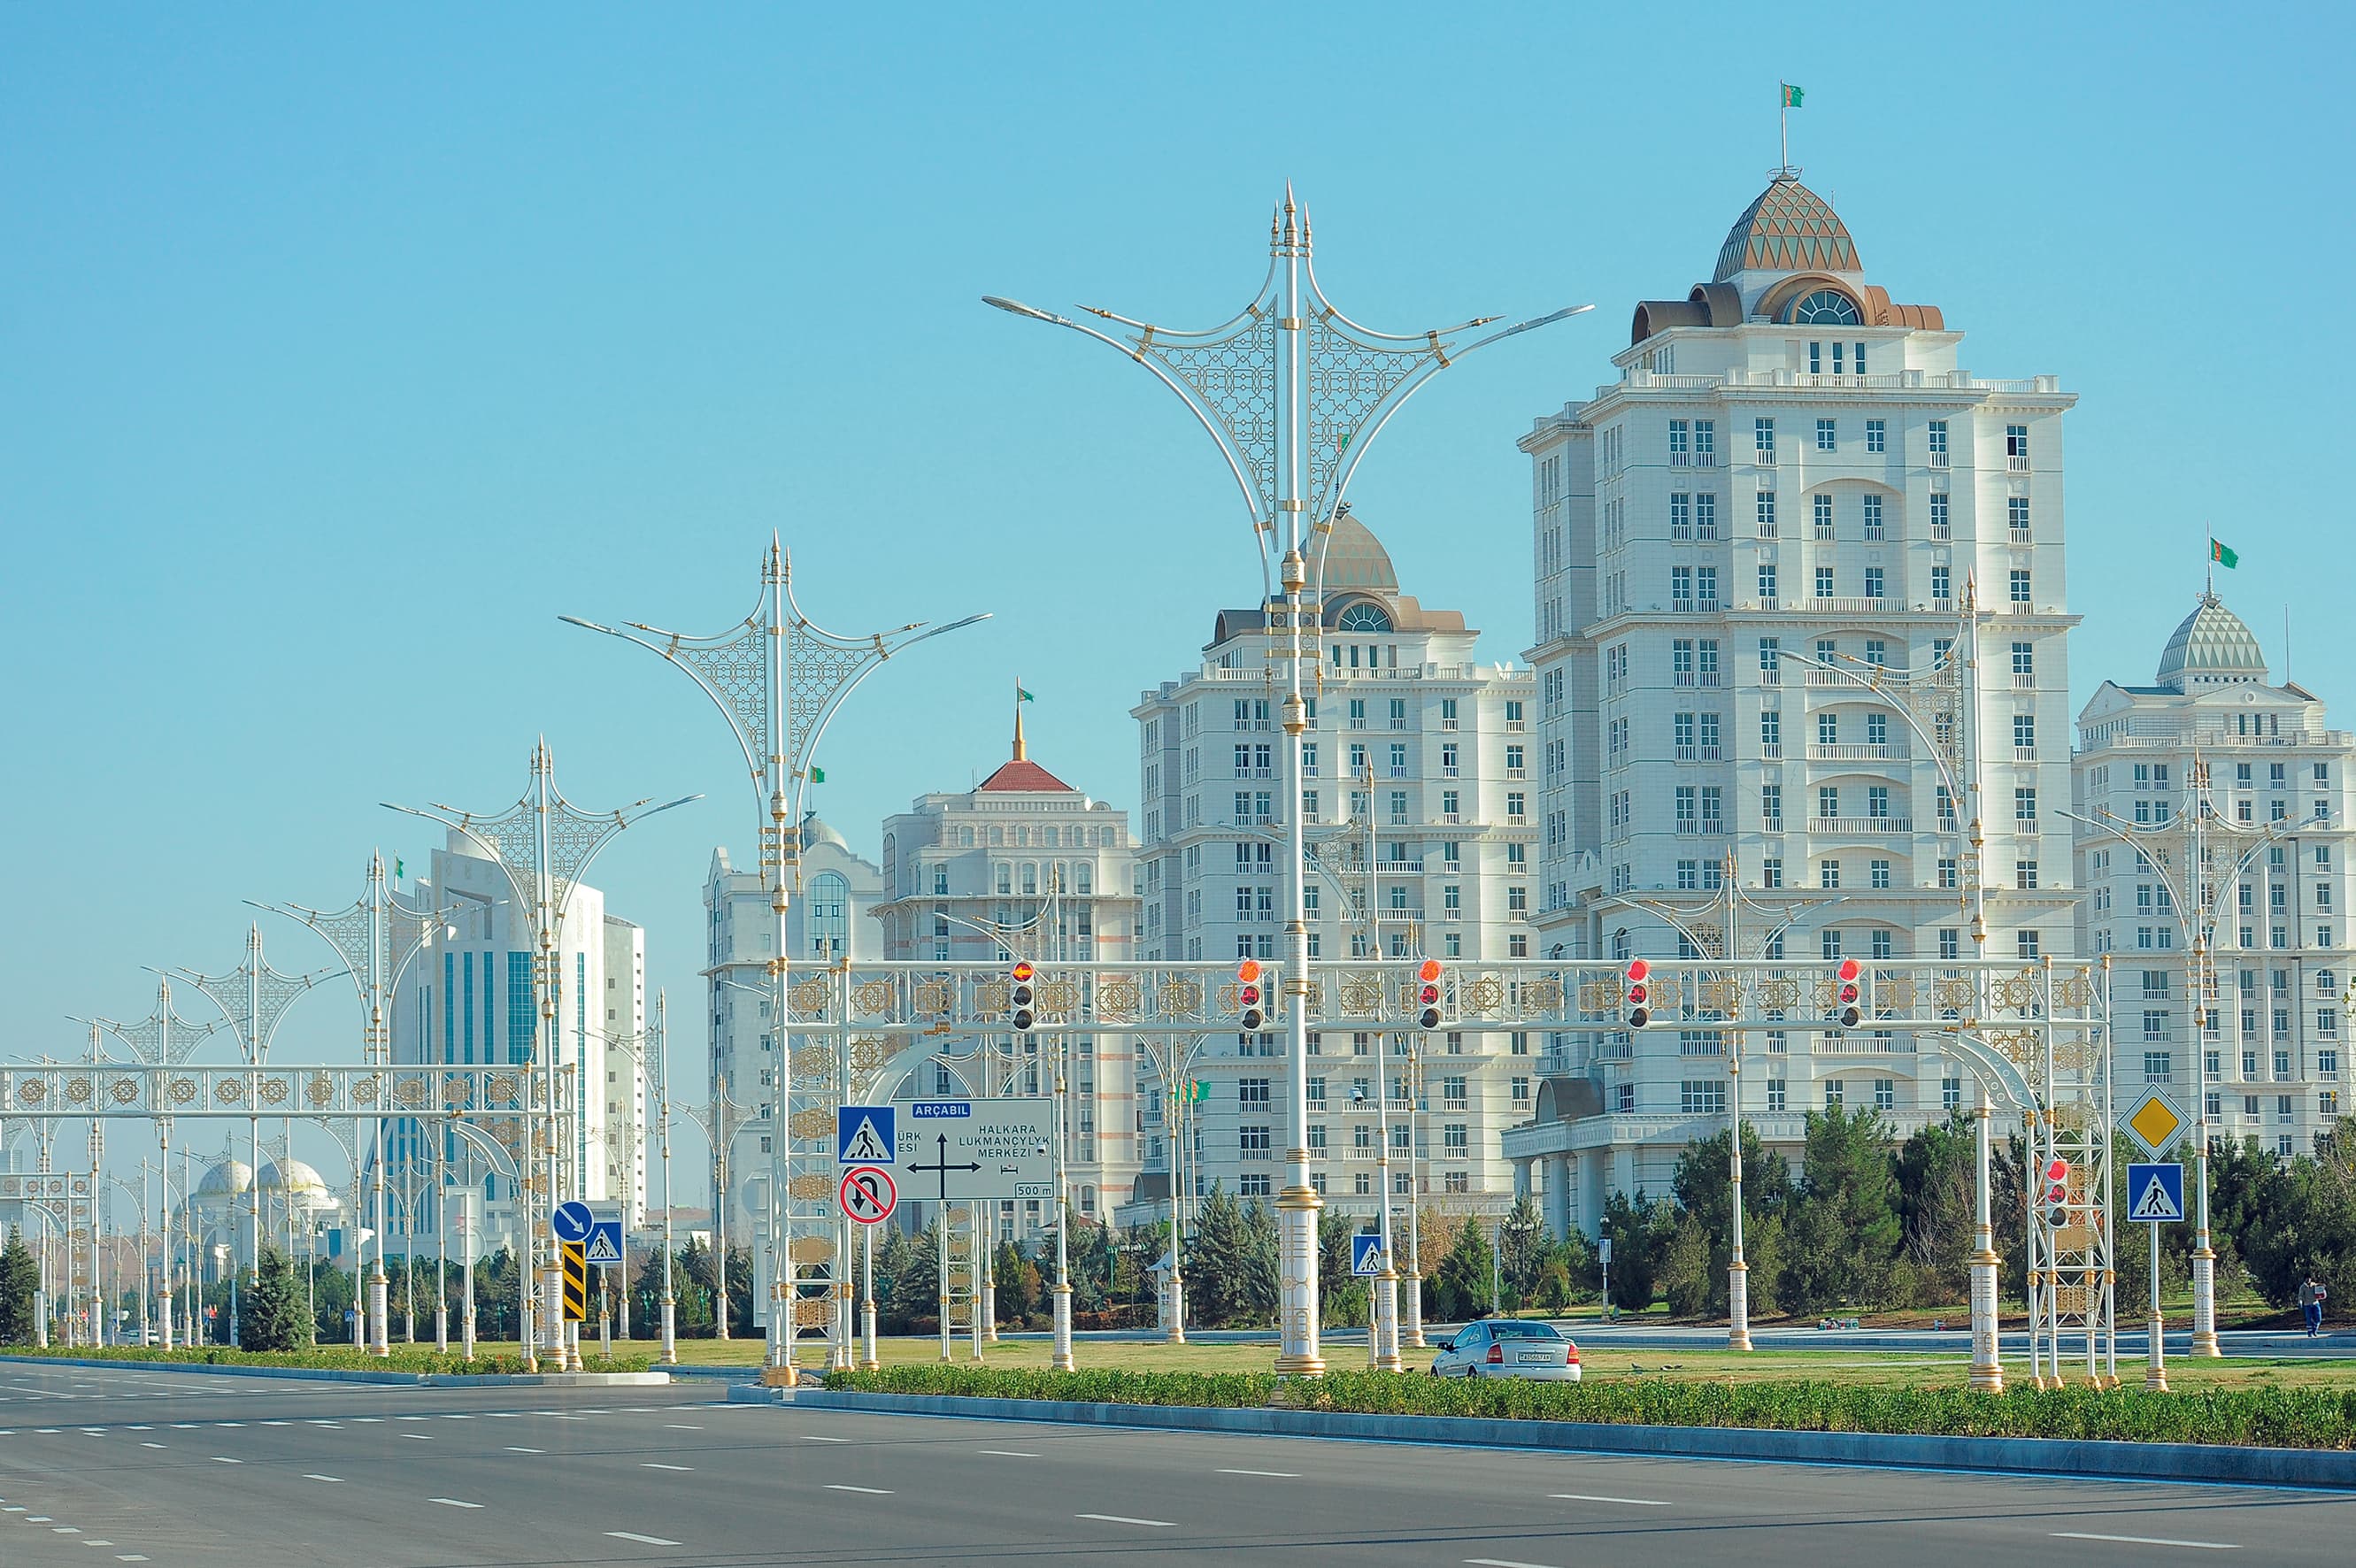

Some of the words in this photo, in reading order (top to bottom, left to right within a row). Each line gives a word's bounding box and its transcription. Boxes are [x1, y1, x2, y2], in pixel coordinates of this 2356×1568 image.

[915, 1105, 968, 1118] ARÇABIL
[979, 1125, 1036, 1134] HALKARA
[897, 1129, 921, 1141] ÜRK
[898, 1142, 917, 1152] ESI
[959, 1136, 1050, 1148] LUKMANÇYLYK
[978, 1148, 1031, 1158] MERKEZI
[1018, 1186, 1039, 1195] 500
